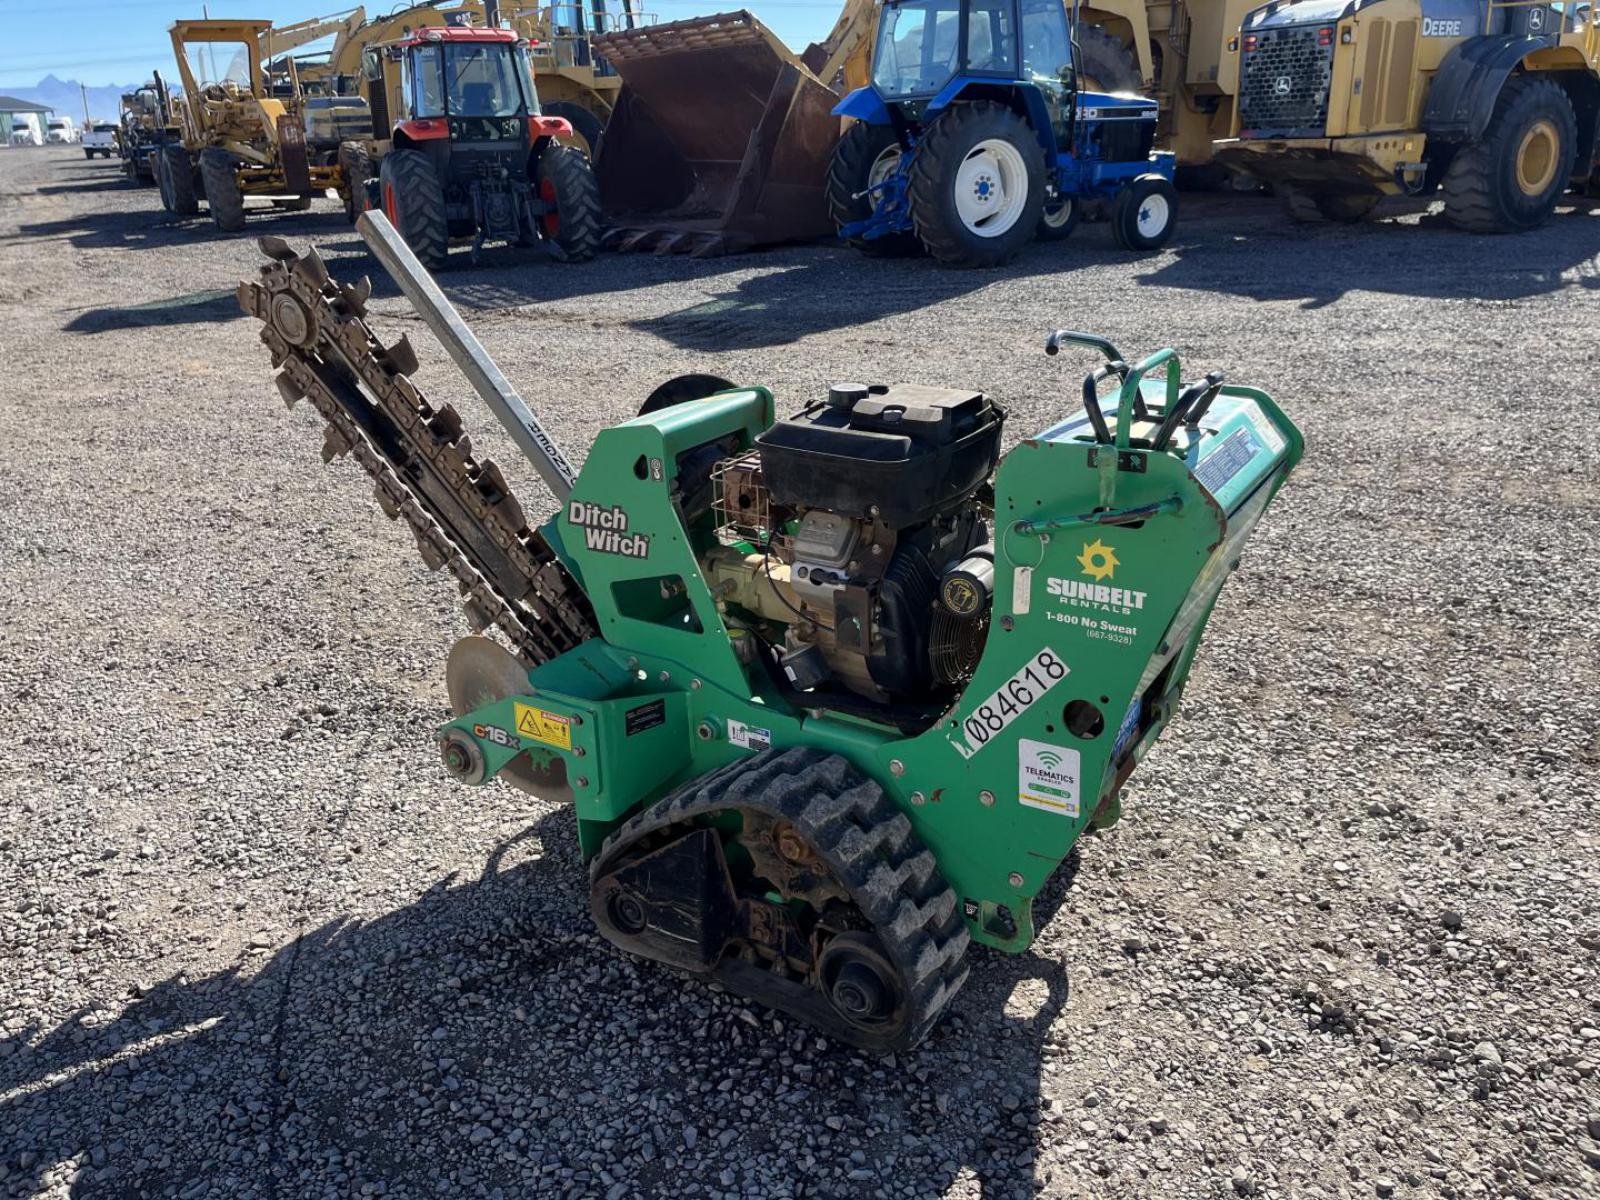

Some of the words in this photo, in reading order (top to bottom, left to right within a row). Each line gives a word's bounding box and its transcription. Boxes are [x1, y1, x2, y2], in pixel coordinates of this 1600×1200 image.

[1423, 18, 1461, 36] DEERE
[569, 501, 627, 530] Ditch
[586, 527, 648, 557] Witch
[1047, 577, 1147, 609] SUNBELT
[1059, 597, 1131, 615] RENTALS
[1046, 611, 1078, 624] 1-800
[1081, 617, 1097, 628] No
[1100, 620, 1137, 635] Sweat
[1086, 629, 1132, 645] (667-9328)
[965, 652, 1065, 744] 084618
[1025, 766, 1074, 783] TELEMATICS
